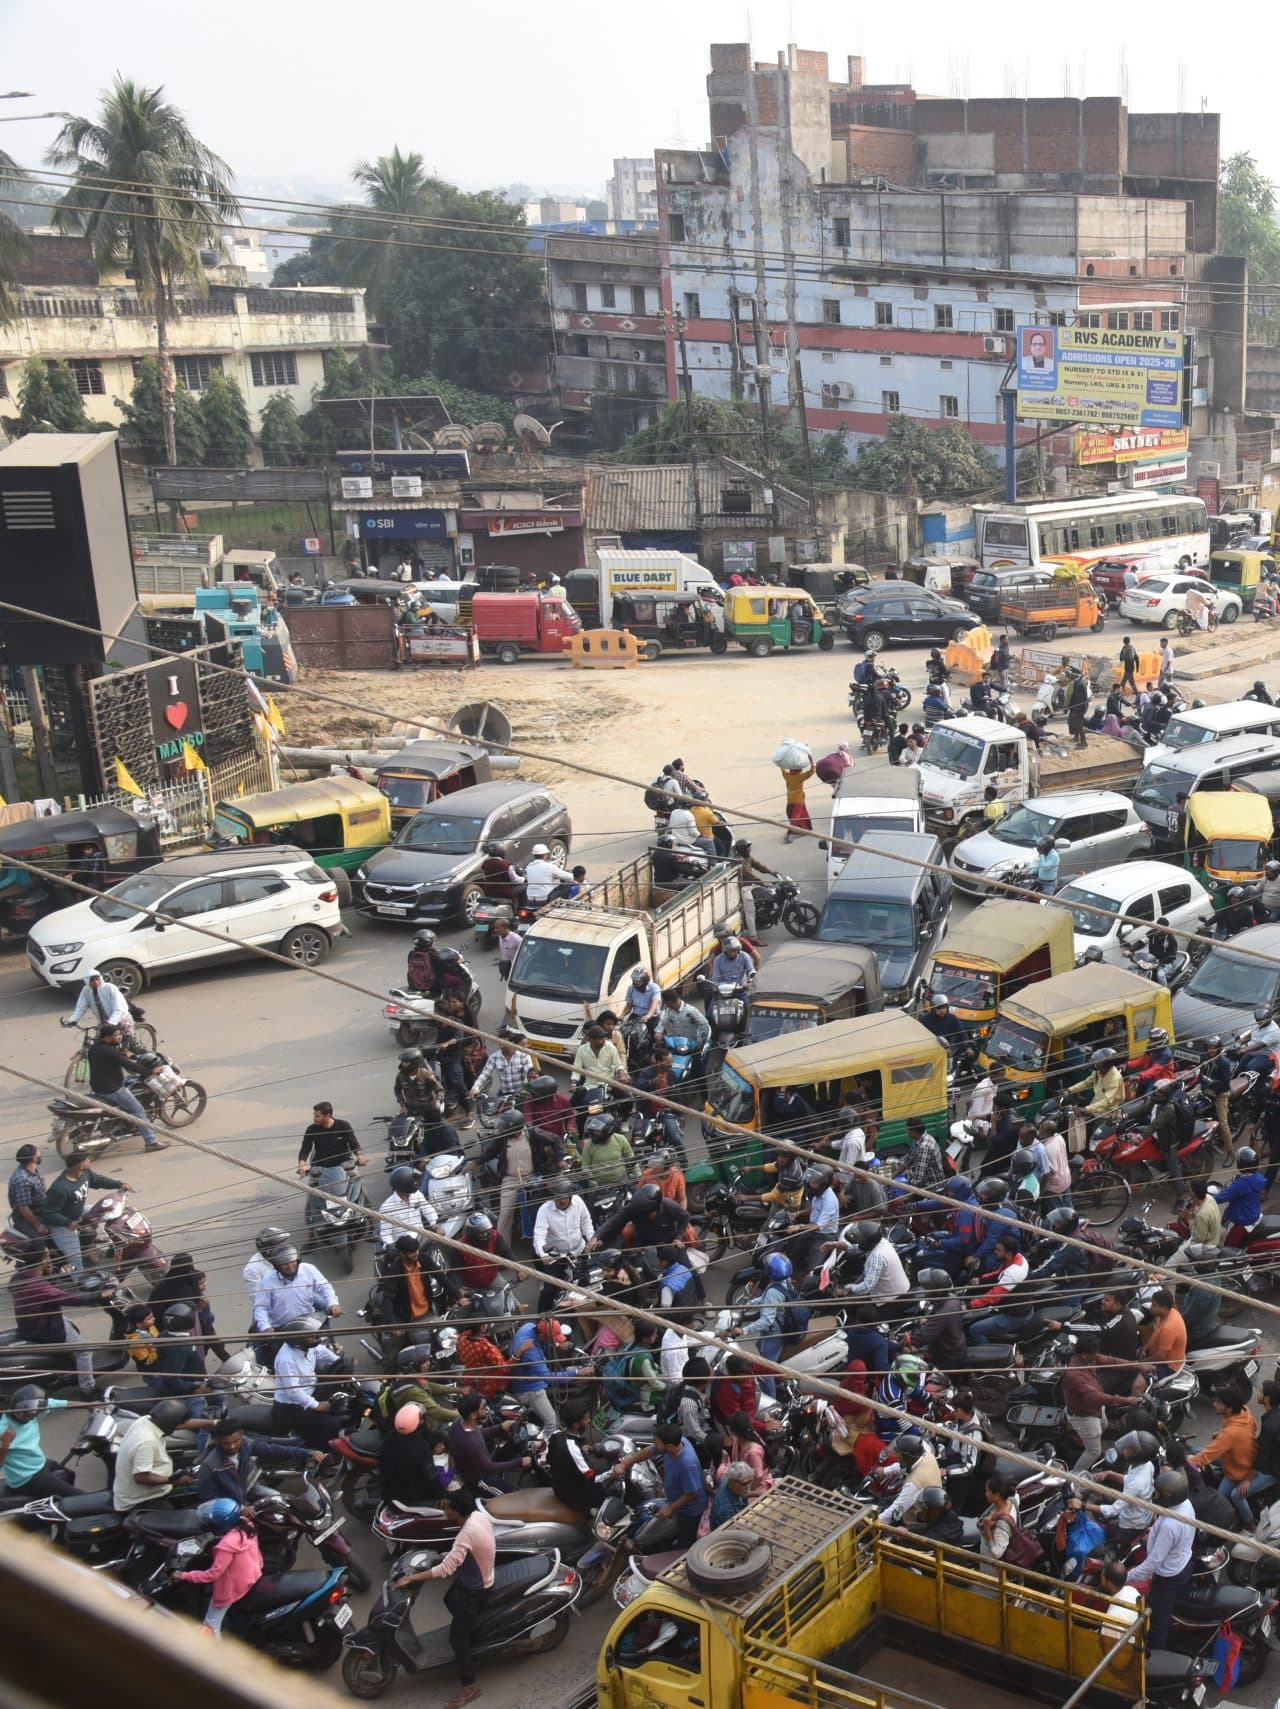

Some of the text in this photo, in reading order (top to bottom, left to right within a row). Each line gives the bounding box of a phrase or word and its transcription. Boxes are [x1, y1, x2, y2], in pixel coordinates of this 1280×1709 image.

[1074, 331, 1161, 349] RVS ACADEMY
[1062, 354, 1175, 368] ADMISSIONS OPEN 2025-26
[1064, 366, 1094, 374] NURSERY
[1064, 379, 1088, 388] Nursery,
[1113, 433, 1160, 451] SKYNET
[377, 519, 395, 528] SBI
[512, 519, 559, 529] ICICI Bank
[613, 572, 672, 582] BLUE DART
[168, 674, 179, 696] I
[159, 731, 205, 760] MANGO
